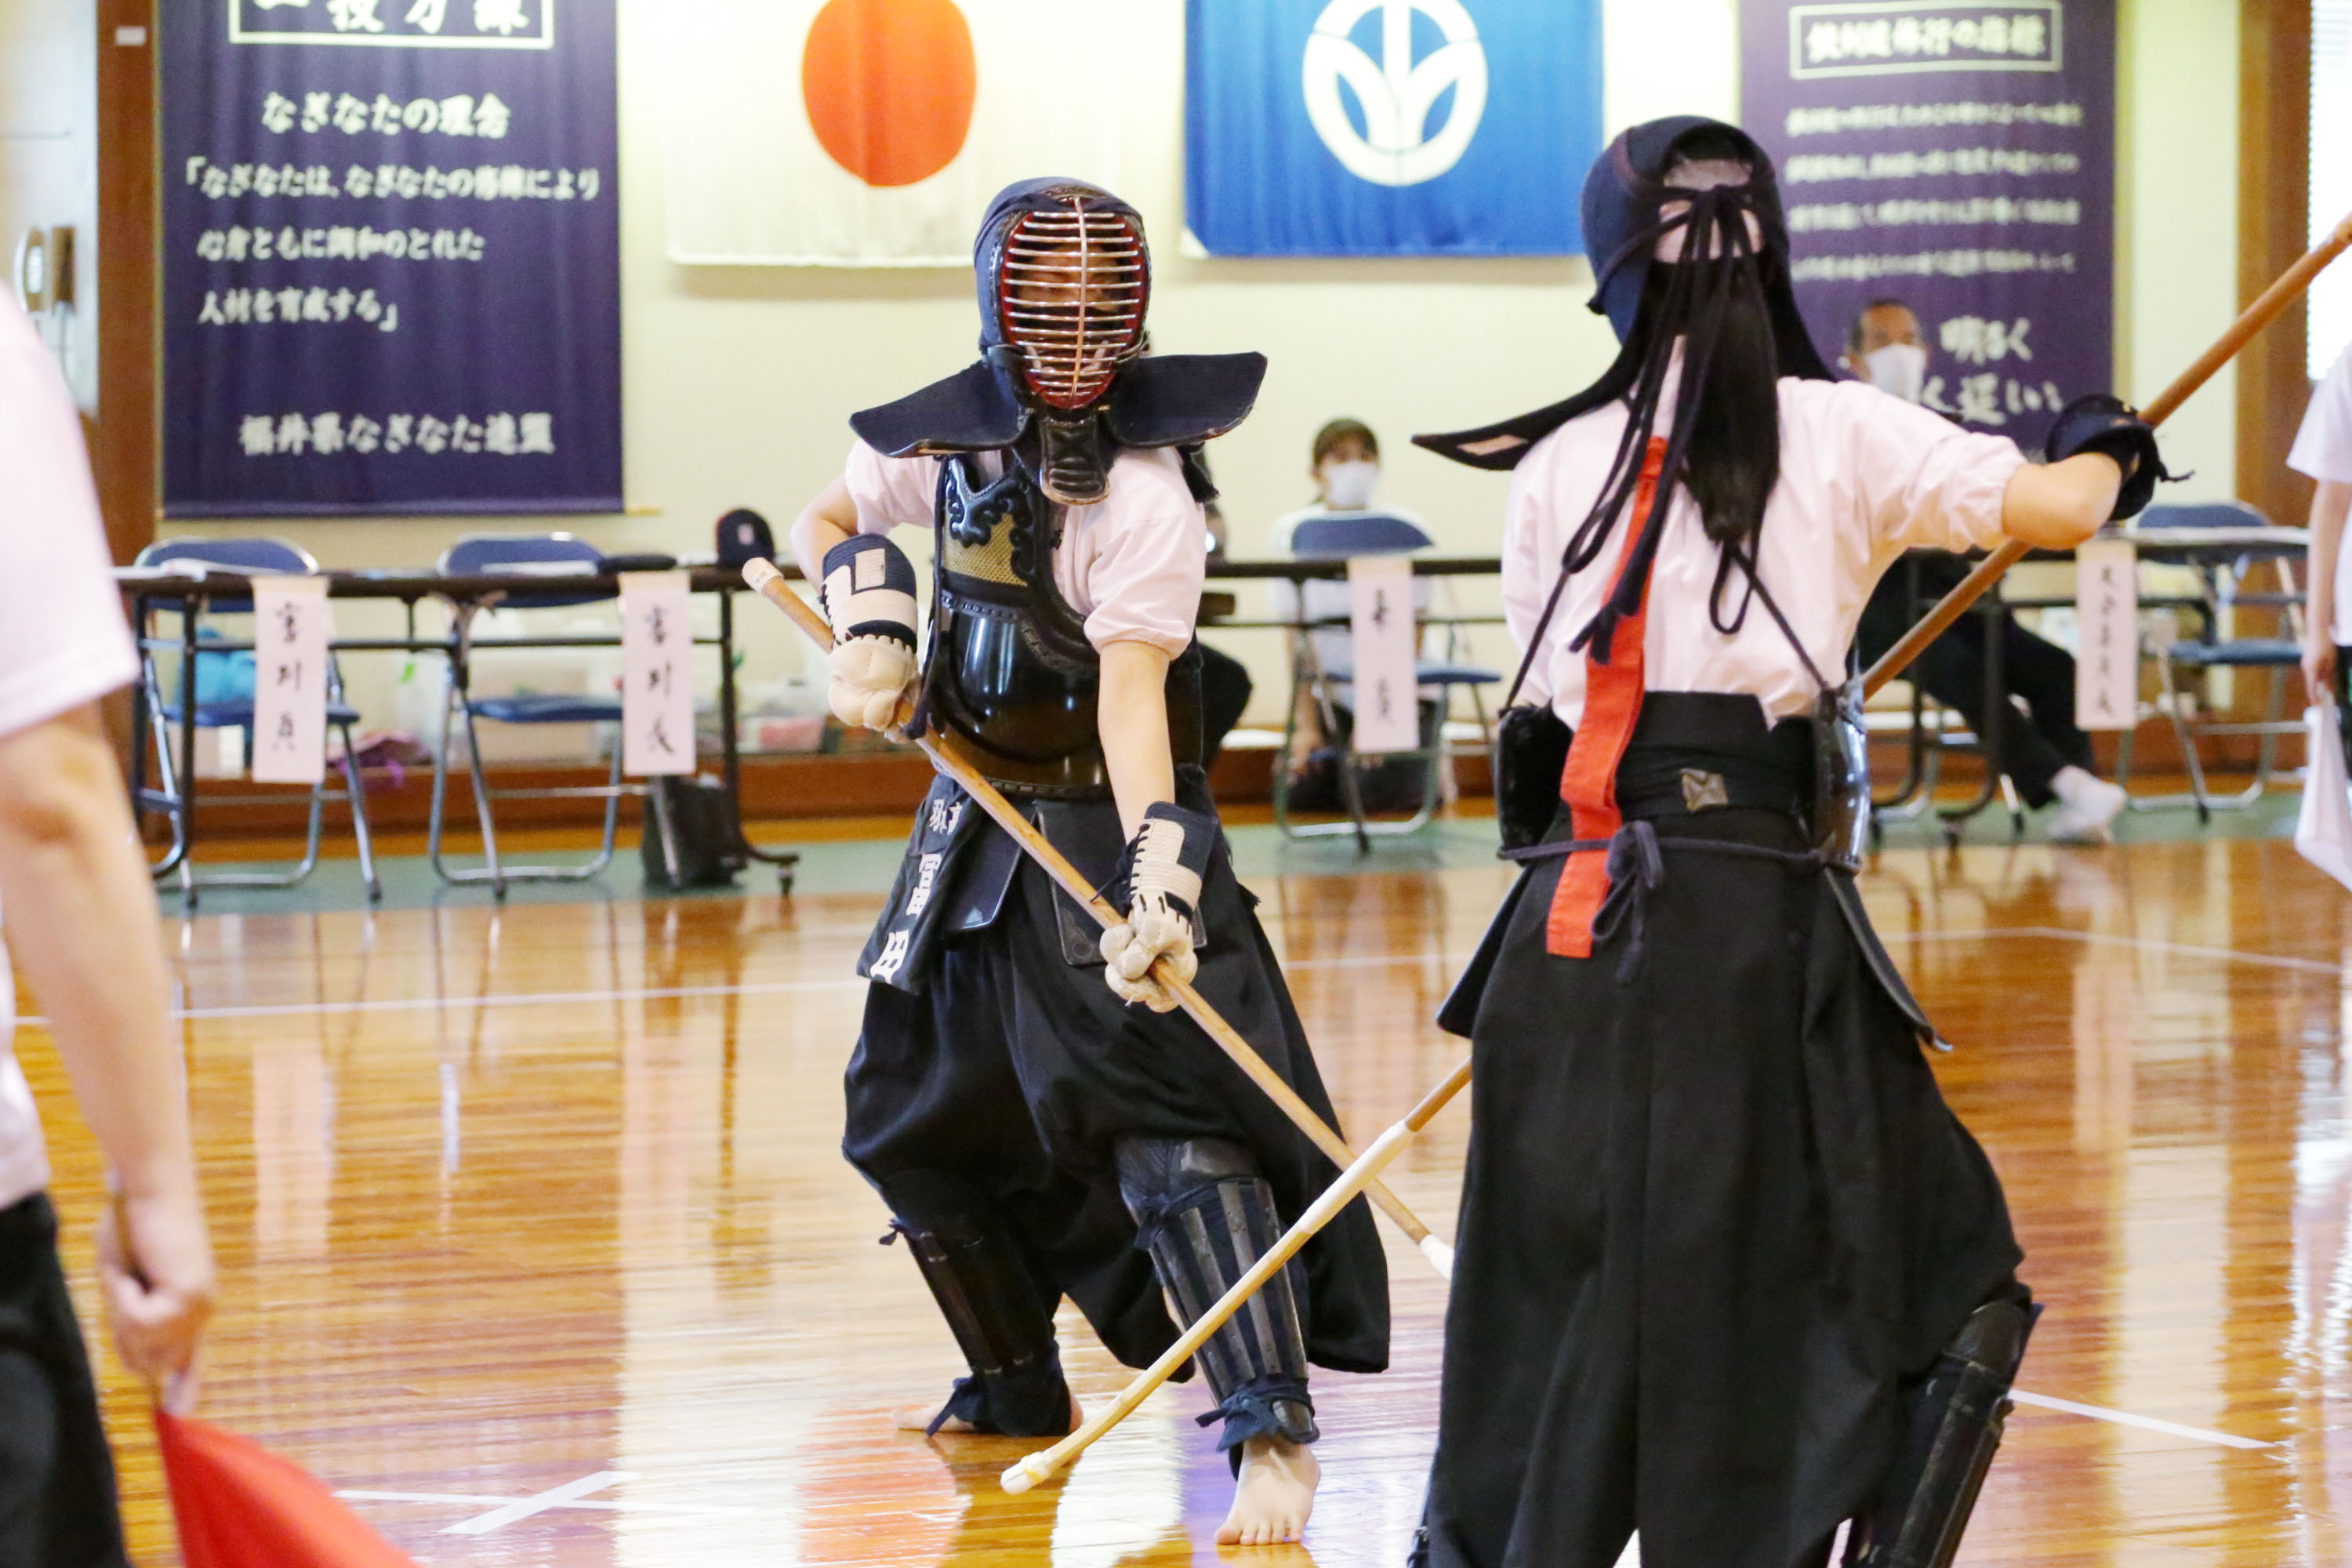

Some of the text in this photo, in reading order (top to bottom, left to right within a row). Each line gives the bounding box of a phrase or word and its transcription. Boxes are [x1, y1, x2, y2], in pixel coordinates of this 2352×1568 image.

[262, 91, 511, 140] なぎなたの理念
[1940, 315, 2032, 365] 明るく
[239, 412, 555, 455] 福井県なぎなた連盟
